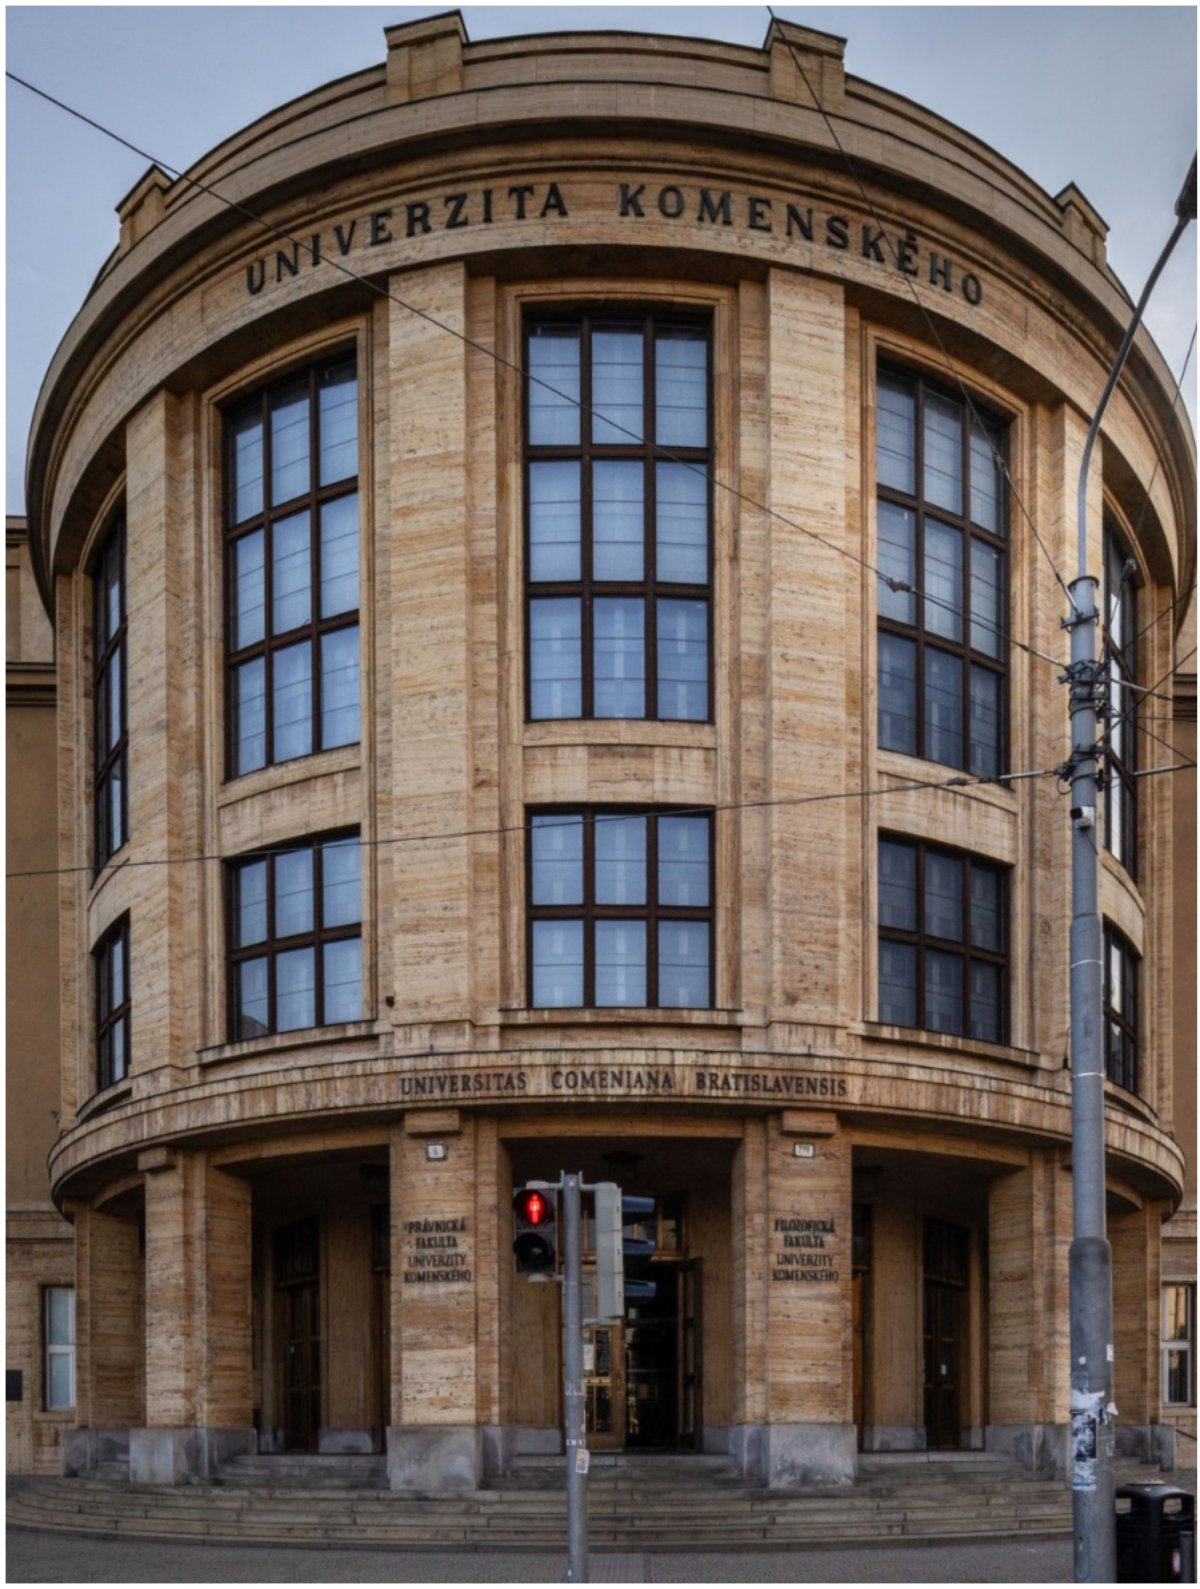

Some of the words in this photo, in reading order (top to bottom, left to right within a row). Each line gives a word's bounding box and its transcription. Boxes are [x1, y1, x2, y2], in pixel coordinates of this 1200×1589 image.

[245, 183, 568, 294] UNIVERZITA
[618, 183, 983, 306] KOMENSKÉHO
[400, 1072, 527, 1095] UNIVERSITAS
[551, 1070, 673, 1090] COMENIANA
[696, 1072, 847, 1096] BRATISLAVENSIS
[408, 1217, 467, 1234] PRÁVNICKÁ
[416, 1235, 458, 1249] FAKULTA
[783, 1234, 825, 1248] FAKULTA
[408, 1253, 467, 1268] UNIVERZITY
[777, 1253, 832, 1267] UNIVERZITY
[404, 1269, 471, 1283] KOMENSKÉHO
